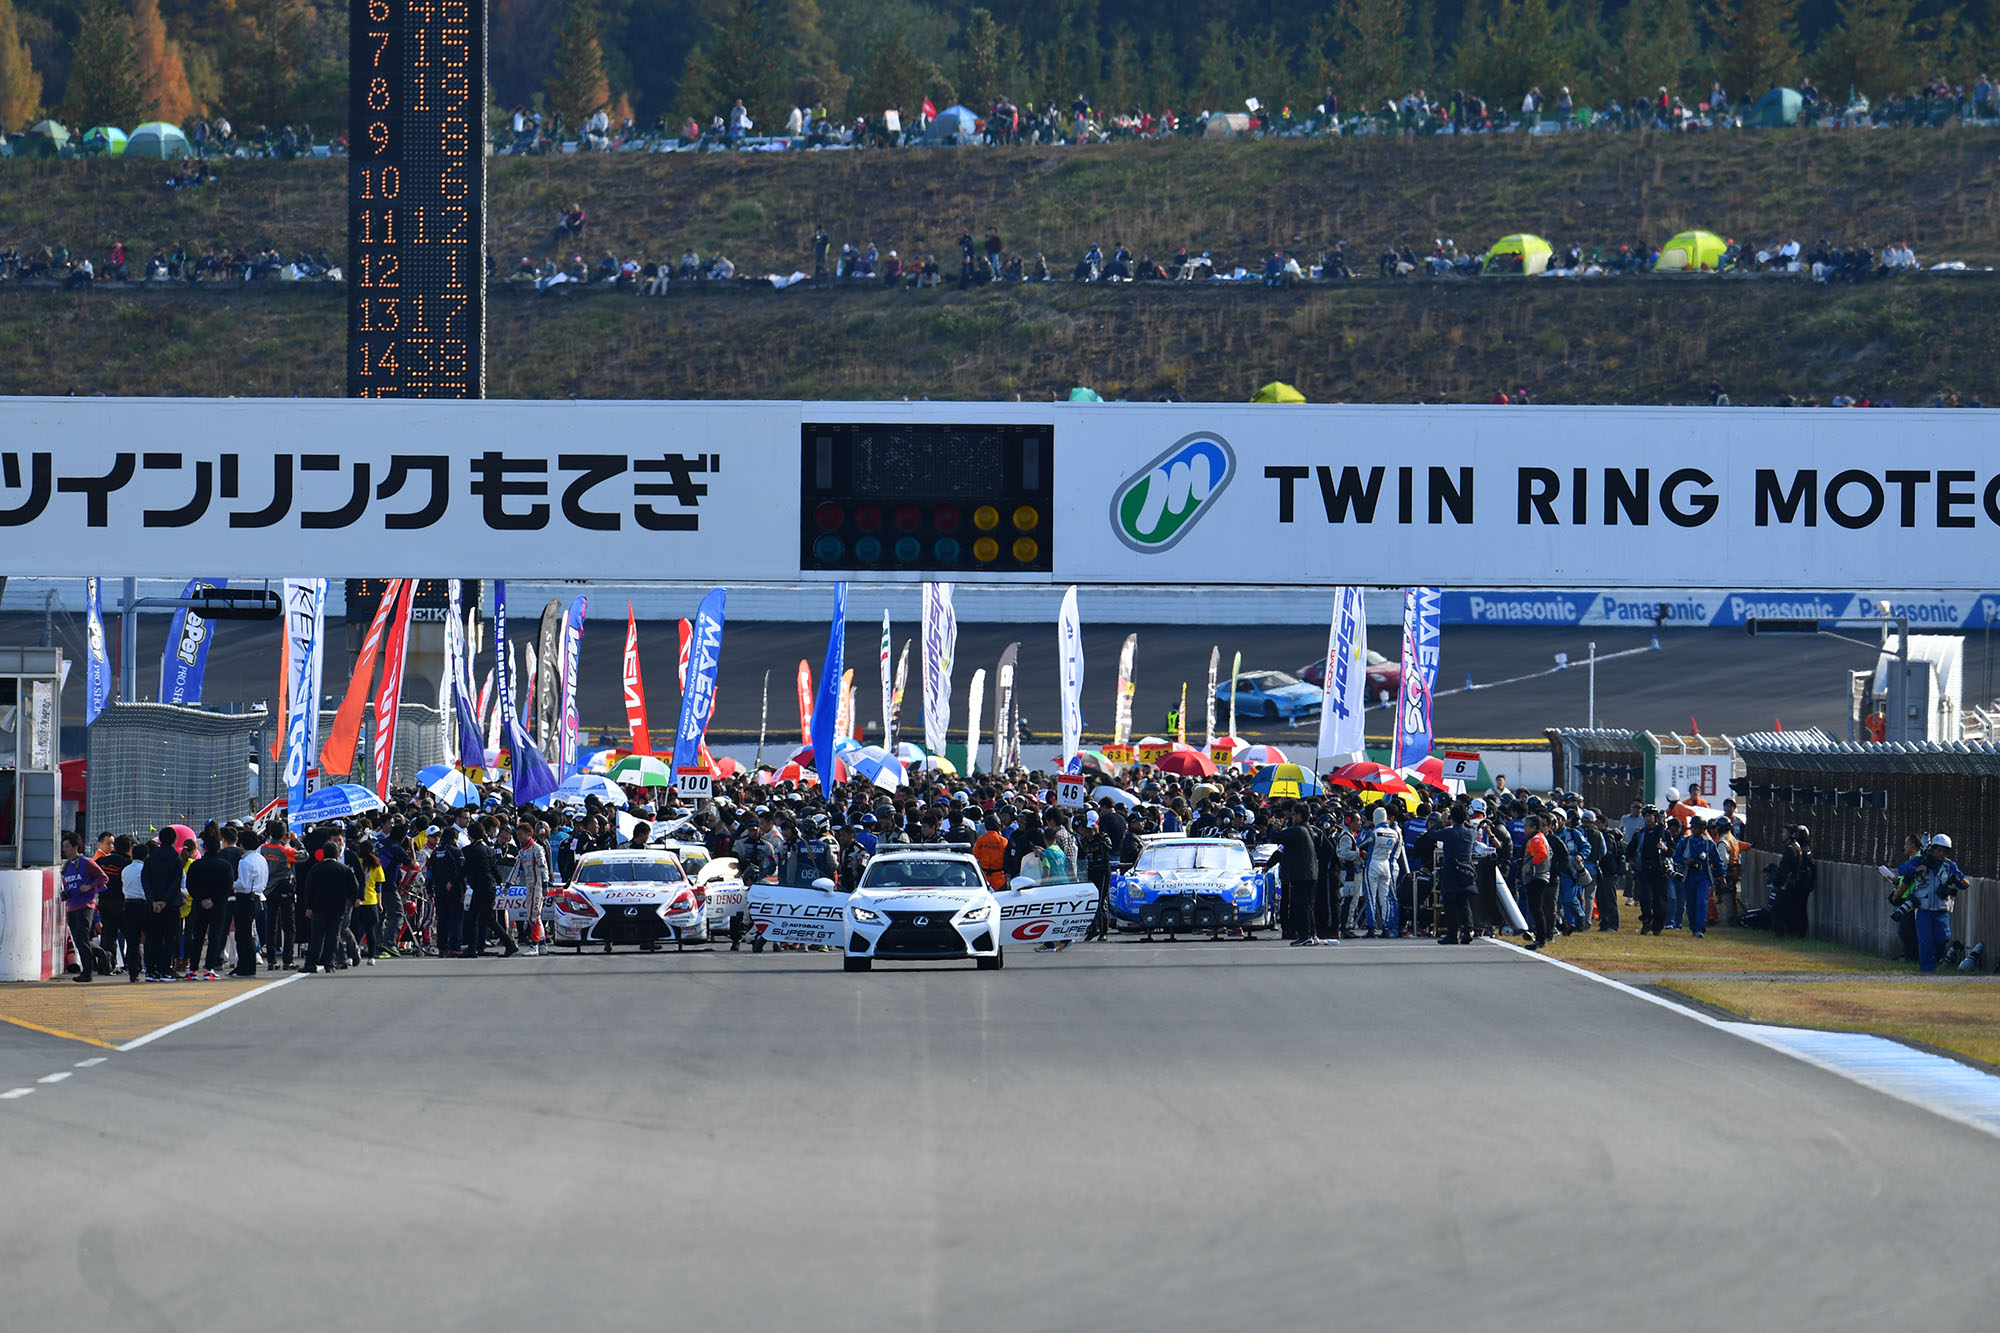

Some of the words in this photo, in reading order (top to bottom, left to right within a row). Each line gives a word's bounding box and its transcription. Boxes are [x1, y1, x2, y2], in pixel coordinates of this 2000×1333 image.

[368, 32, 390, 67] 7
[414, 28, 469, 68] 15
[367, 77, 391, 111] 8
[414, 73, 469, 112] 19
[368, 121, 390, 155] 9
[441, 117, 469, 156] 8
[360, 165, 400, 200] 10
[441, 161, 469, 200] 6
[360, 209, 398, 244] 11
[413, 206, 468, 244] 12
[360, 253, 400, 288] 12
[445, 249, 462, 288] 1
[359, 298, 400, 332] 13
[412, 294, 468, 333] 17
[359, 341, 400, 376] 14
[406, 338, 467, 376] 38
[1264, 466, 1474, 523] TWIN
[1517, 467, 1719, 525] RING
[1755, 470, 2000, 529] MOTE
[412, 606, 449, 621] EIK
[1469, 596, 1577, 620] Panasonic
[1730, 597, 1834, 621] Panasonic
[694, 627, 703, 656] SHELL
[176, 665, 188, 686] PRO
[686, 615, 722, 741] MAEDA
[687, 657, 699, 699] SERVICE
[1107, 750, 1121, 760] 63
[1144, 751, 1151, 759] 2
[1214, 751, 1228, 761] 48
[1455, 760, 1466, 773] 6
[680, 776, 709, 790] 100
[1062, 784, 1078, 800] 46
[318, 806, 352, 819] KOBELCO
[605, 890, 657, 899] DENSO
[1153, 880, 1227, 890] Engineering
[492, 899, 527, 909] ENS
[716, 893, 743, 905] DENSO
[804, 905, 844, 918] CAR
[1000, 900, 1084, 918] SAFETY
[772, 928, 815, 937] SUPER
[817, 931, 836, 939] GT
